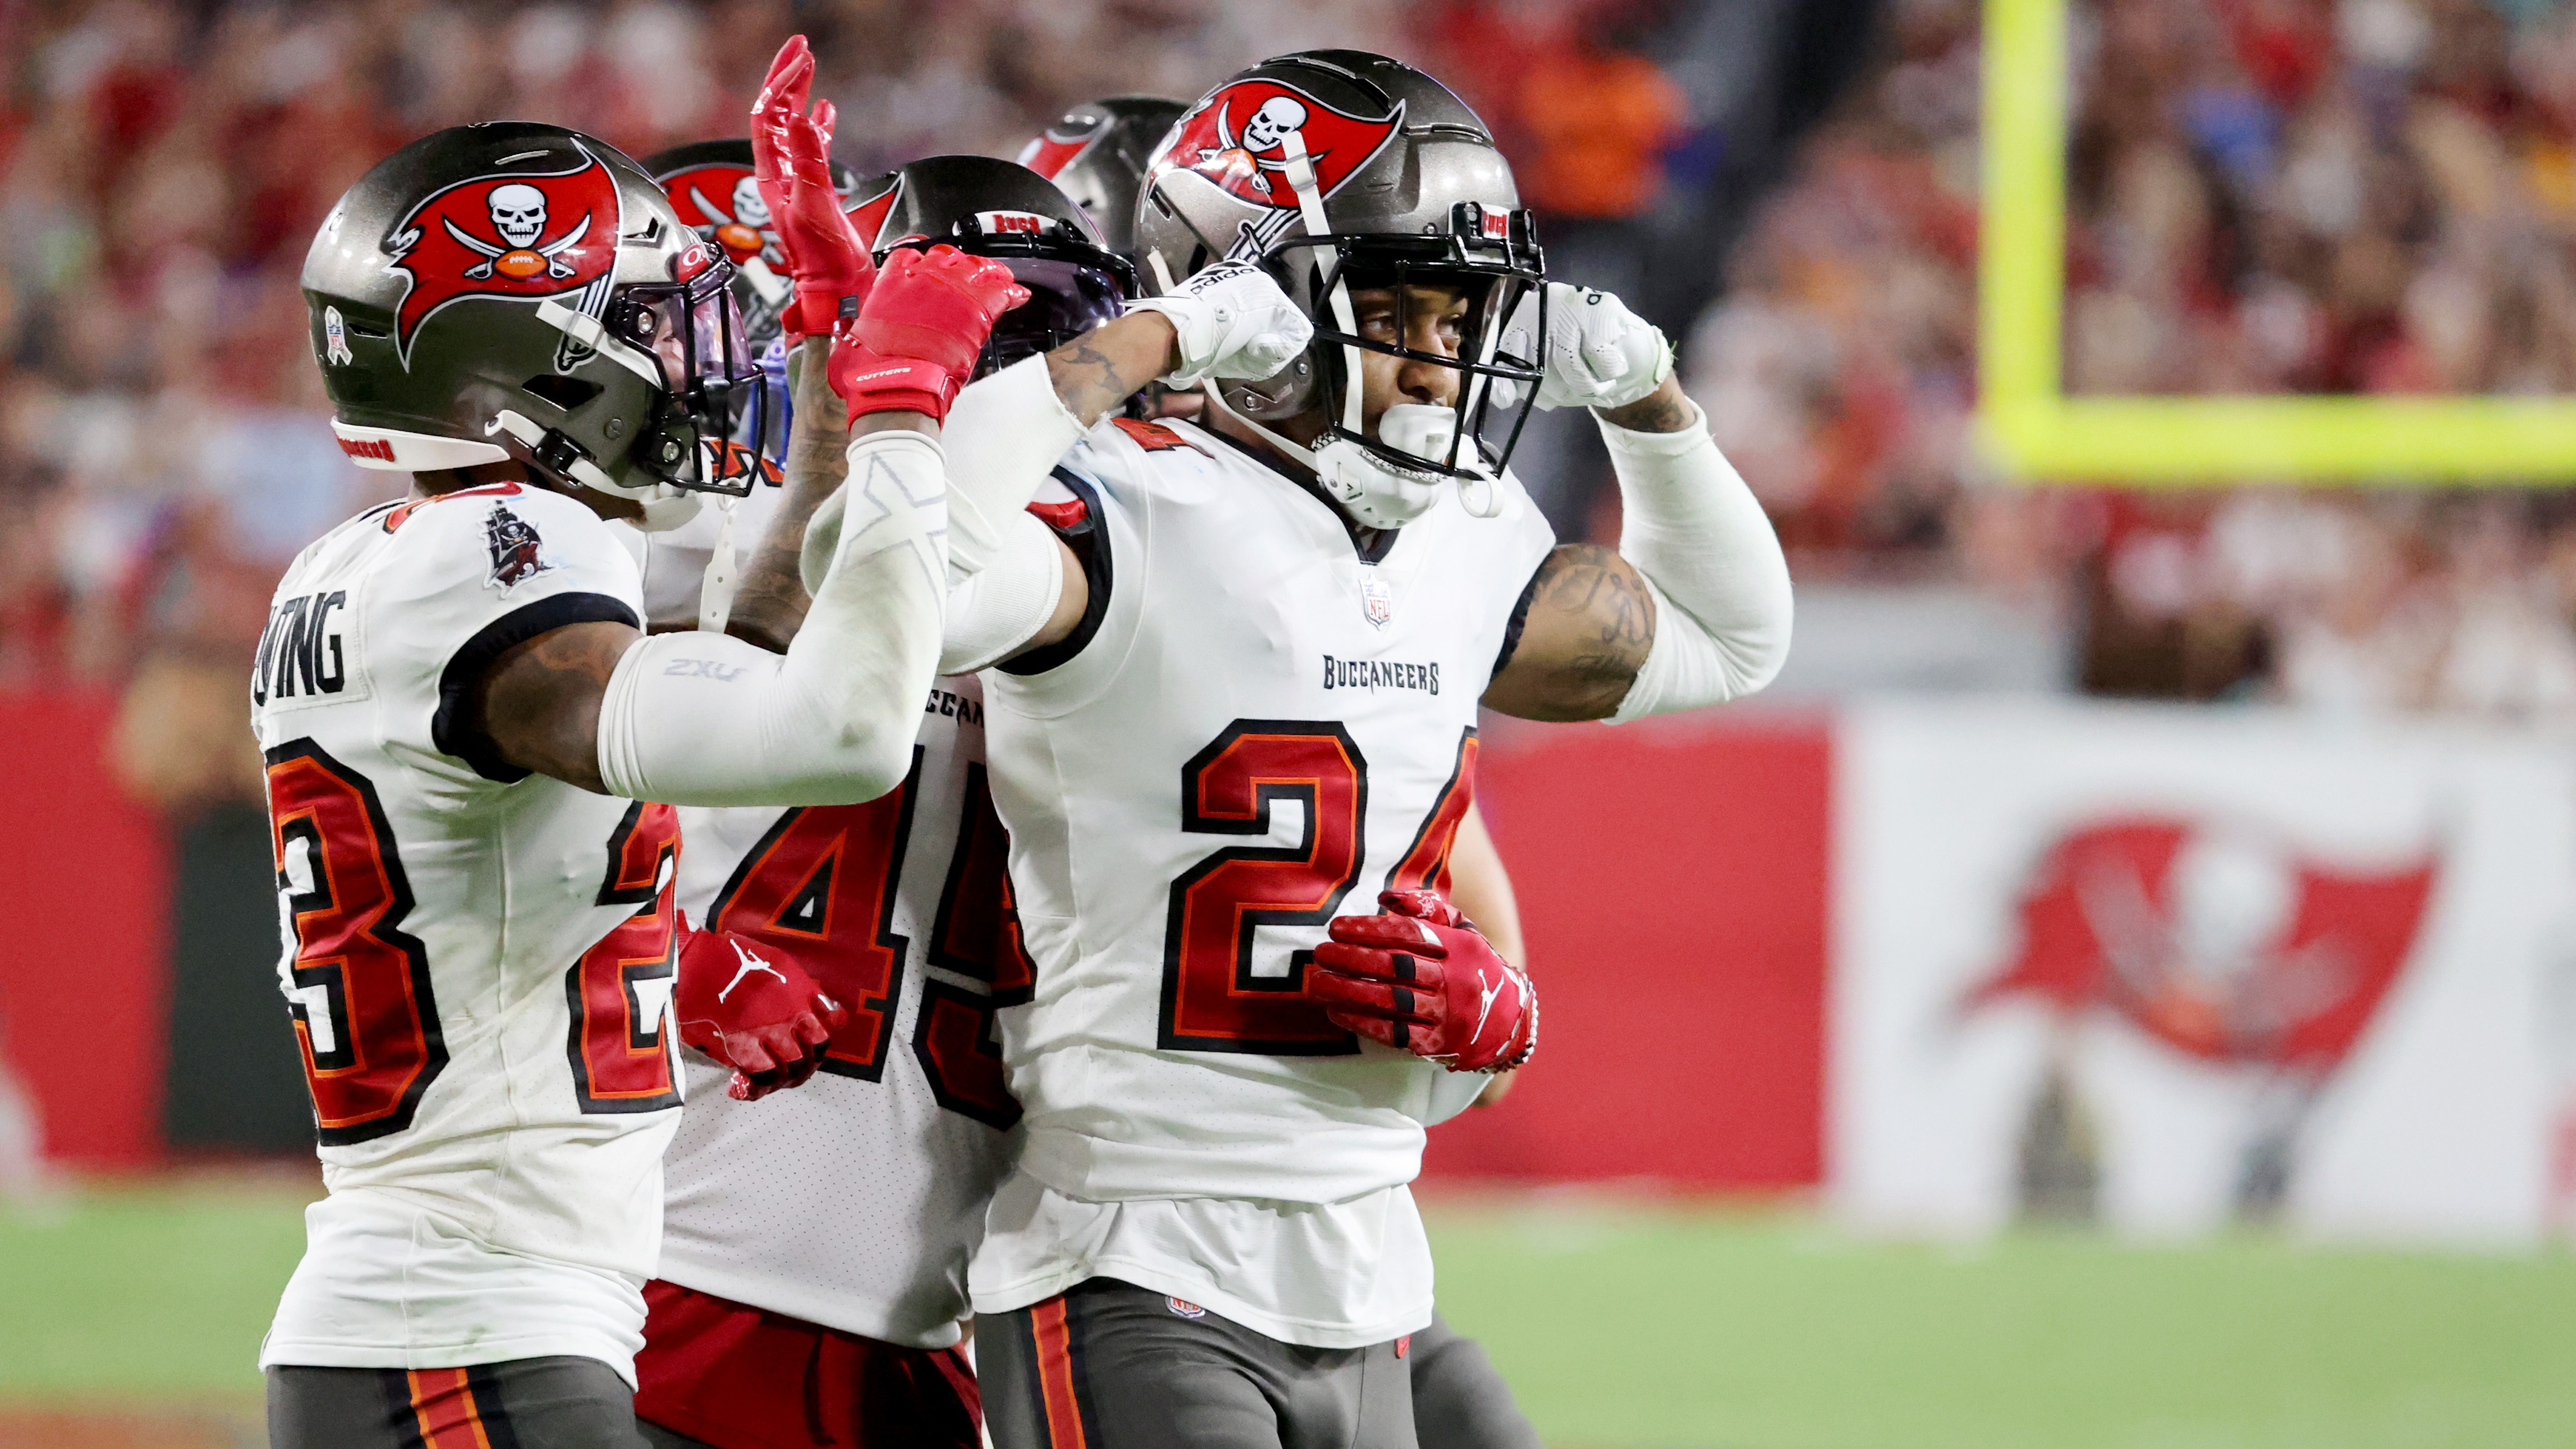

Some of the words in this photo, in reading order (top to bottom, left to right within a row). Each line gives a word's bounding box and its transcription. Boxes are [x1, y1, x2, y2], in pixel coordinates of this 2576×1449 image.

[856, 367, 912, 382] CUTTERS
[1369, 599, 1389, 620] NFL
[1322, 654, 1439, 695] BUCCANEERS
[705, 744, 1038, 1132] 45
